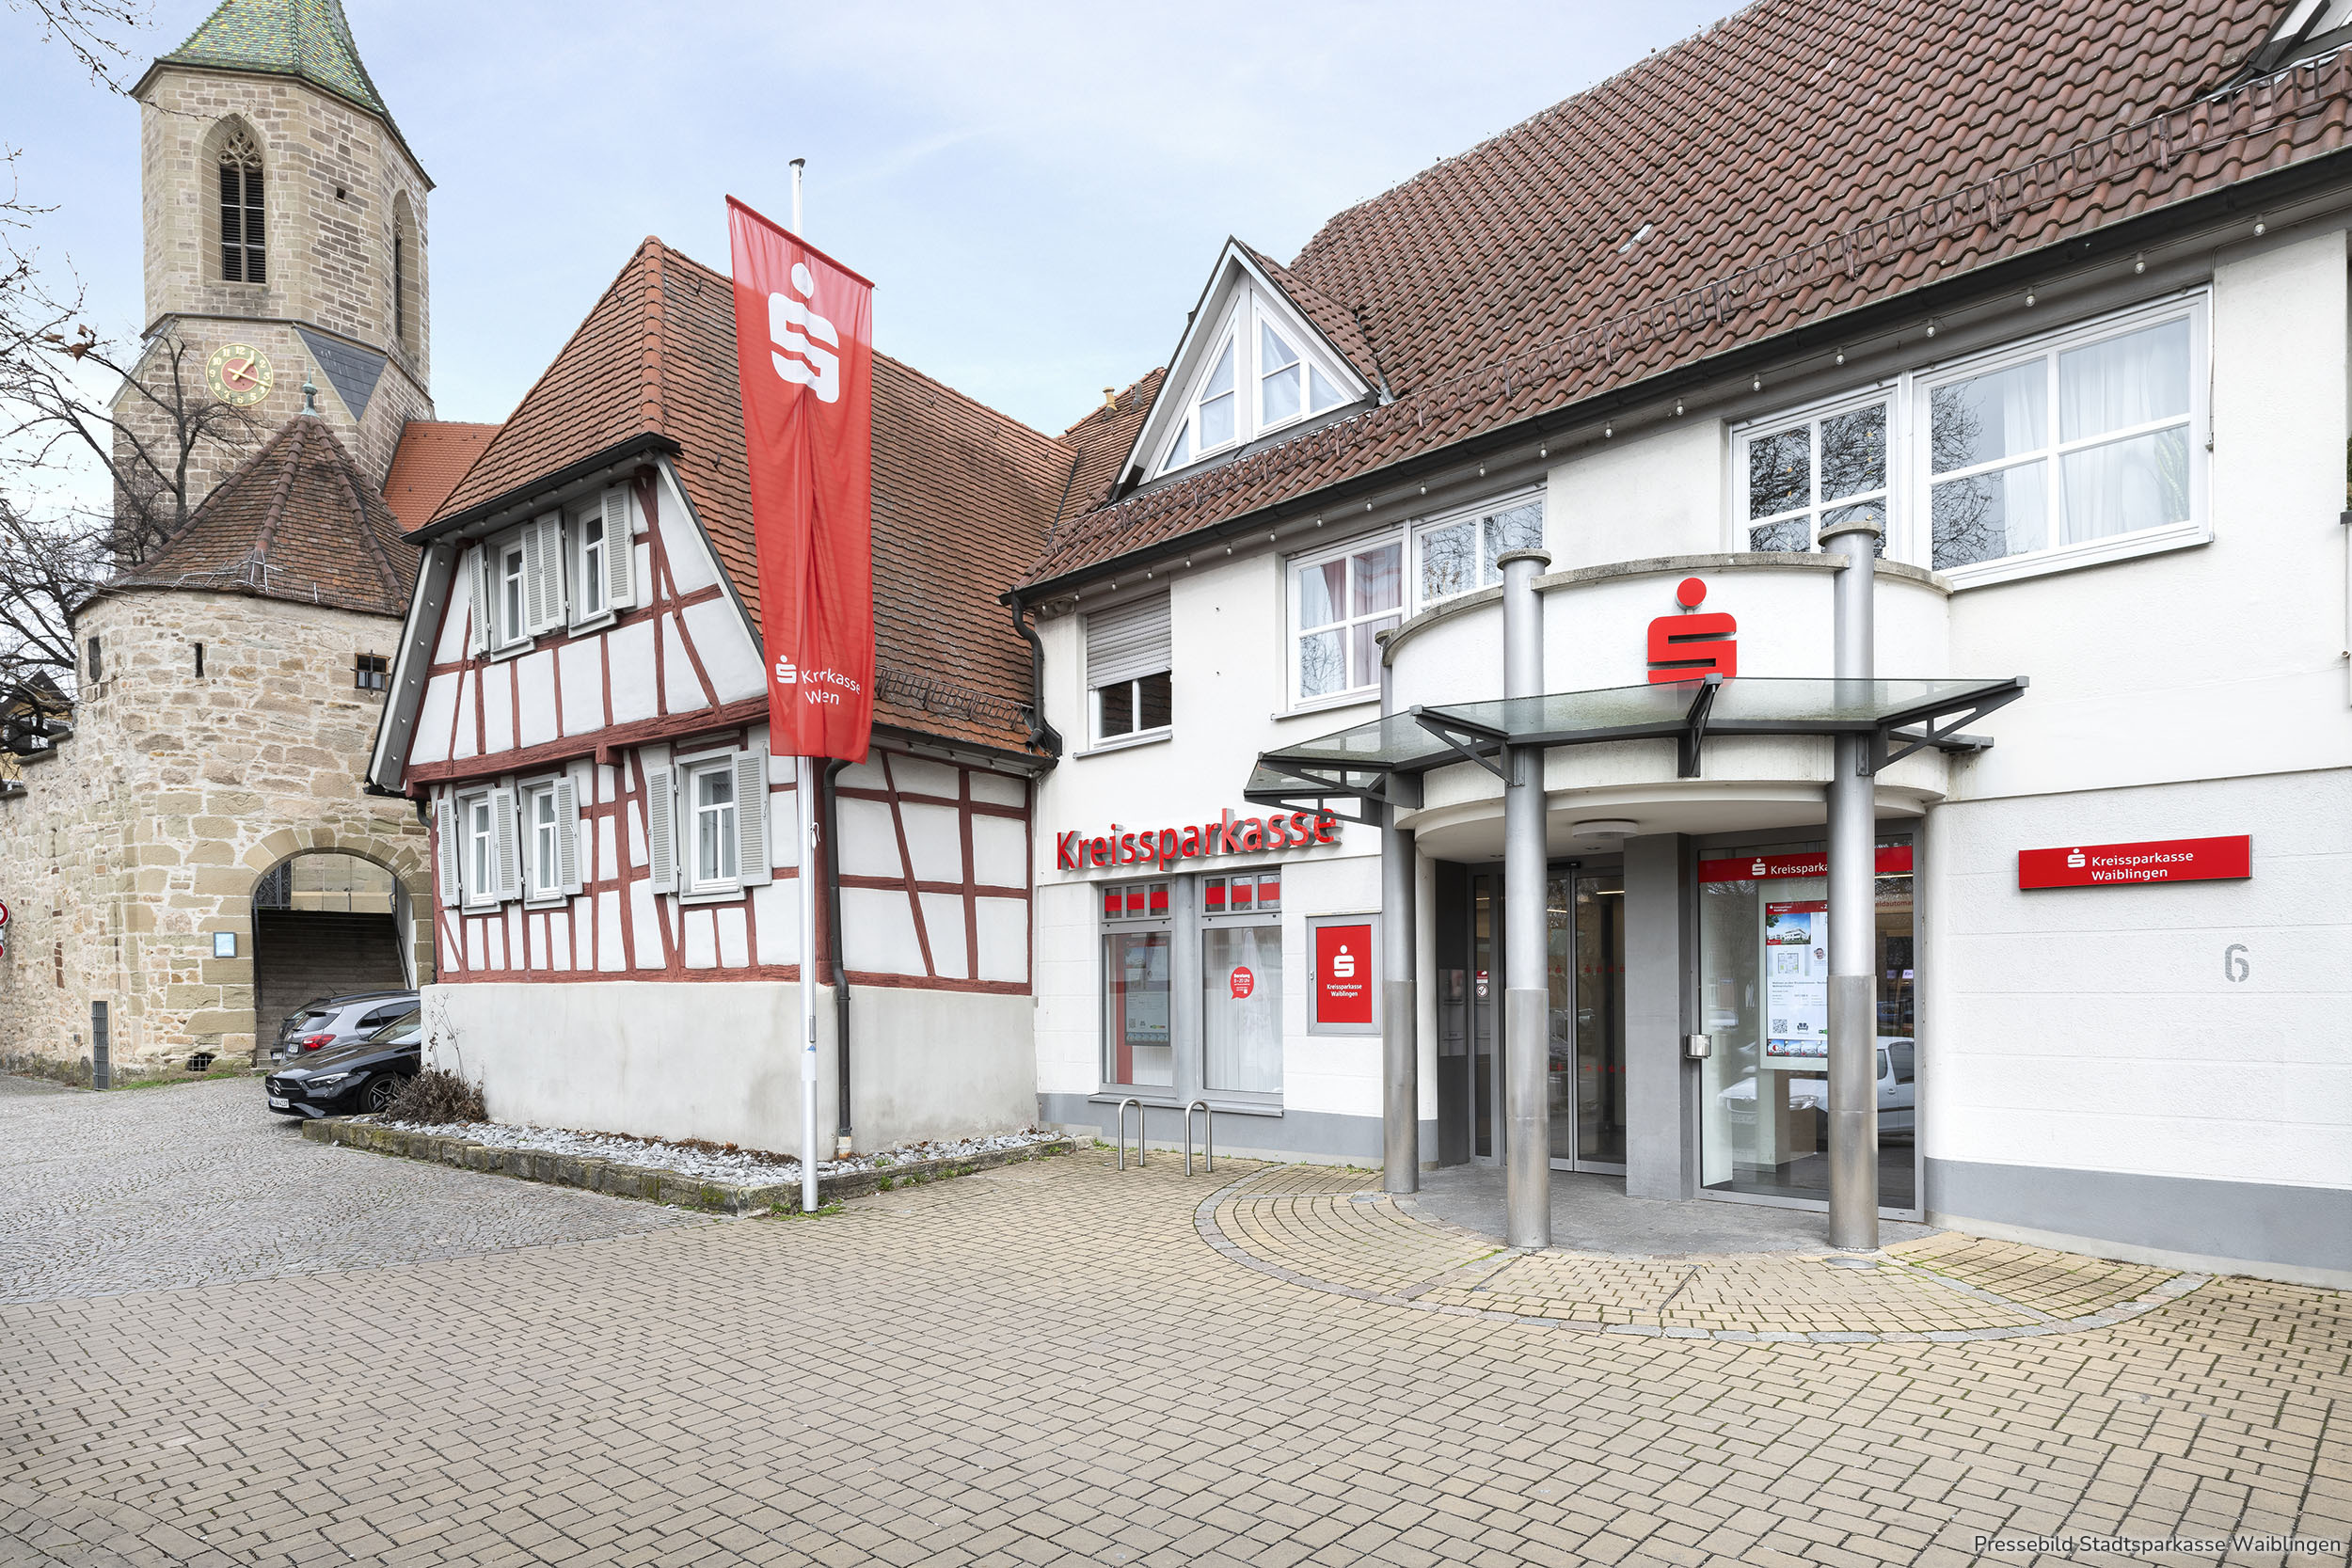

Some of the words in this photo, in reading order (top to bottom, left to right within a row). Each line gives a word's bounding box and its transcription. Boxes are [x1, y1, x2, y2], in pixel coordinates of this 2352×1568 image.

[236, 346, 245, 355] 12
[1057, 807, 1338, 872] Kreissparkasse
[2091, 852, 2194, 867] Kreissparkasse
[2090, 868, 2169, 881] Waiblingen
[2224, 942, 2250, 983] 6
